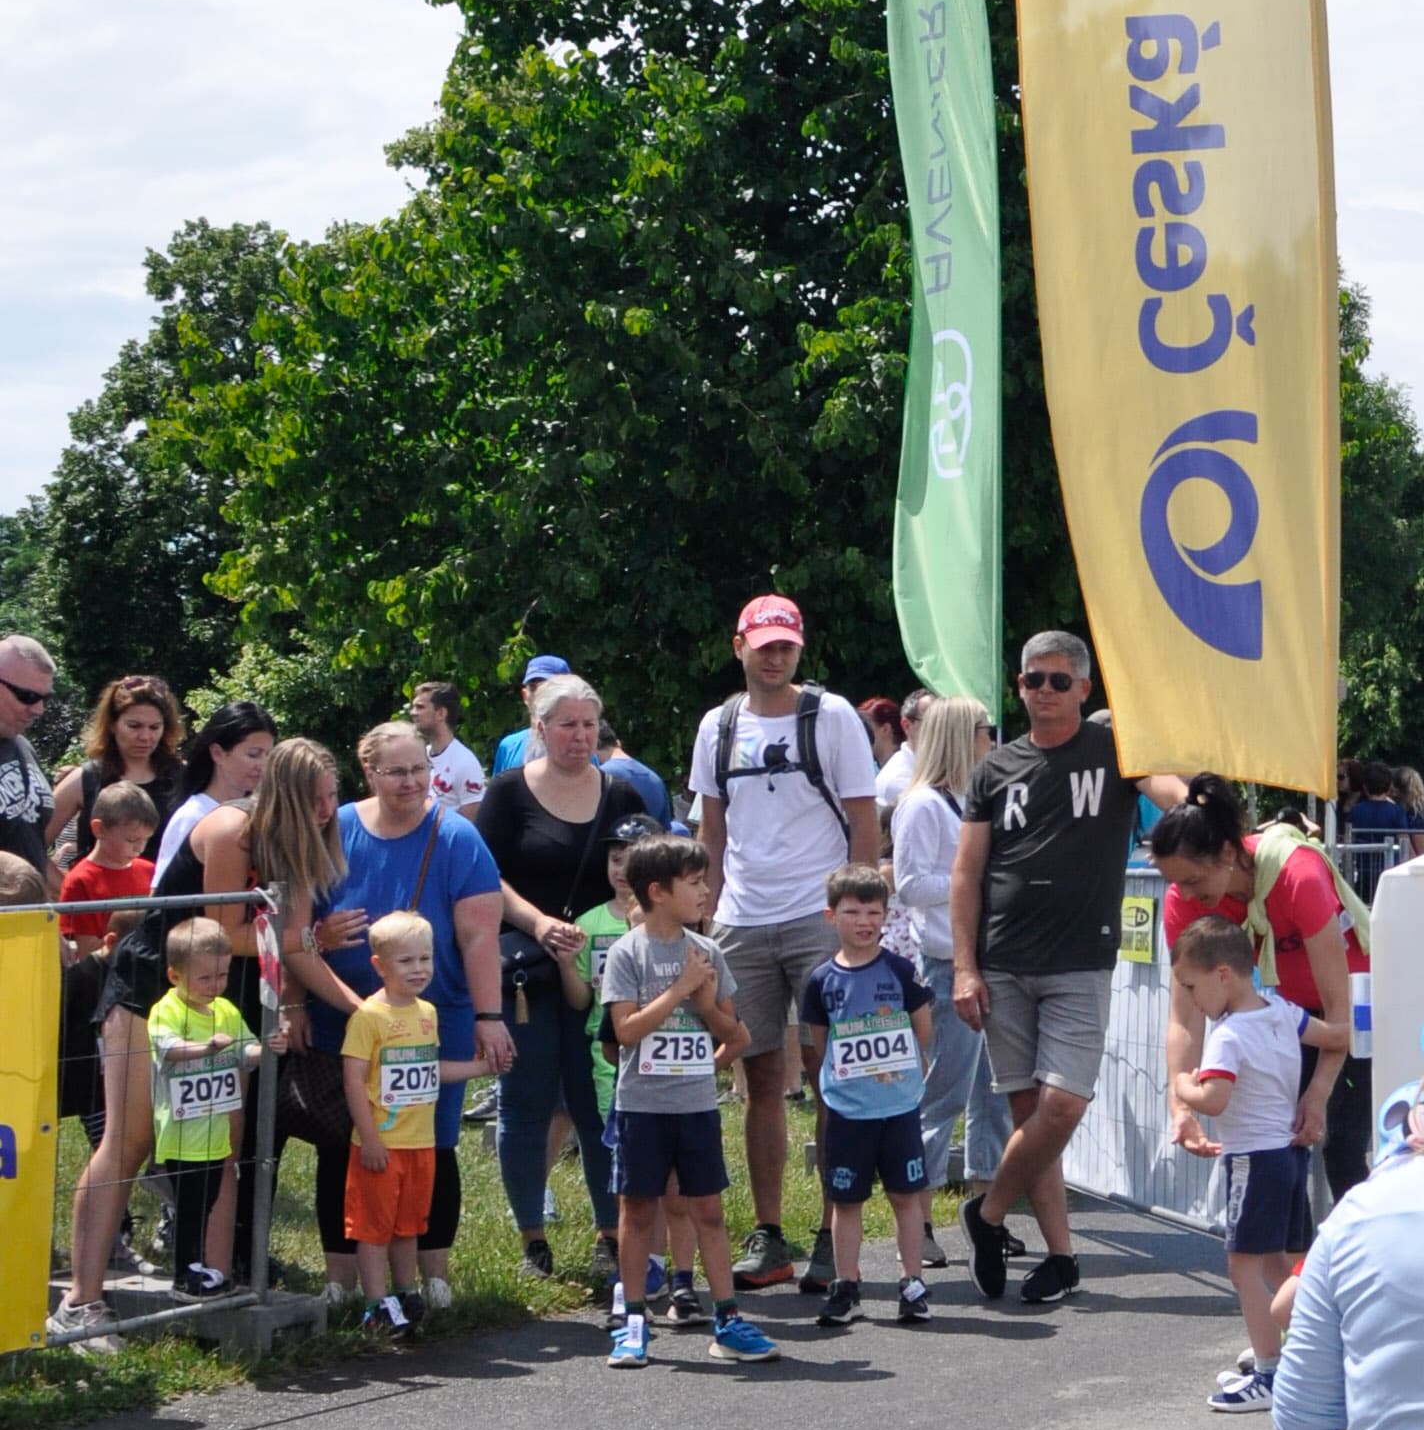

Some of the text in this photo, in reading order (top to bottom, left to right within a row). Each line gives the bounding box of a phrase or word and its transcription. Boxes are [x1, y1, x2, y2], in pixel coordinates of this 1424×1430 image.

[1069, 767, 1105, 818] W
[652, 1035, 707, 1061] 2136
[839, 1033, 909, 1065] 2004
[178, 1072, 236, 1105] 2079
[389, 1064, 438, 1092] 2076
